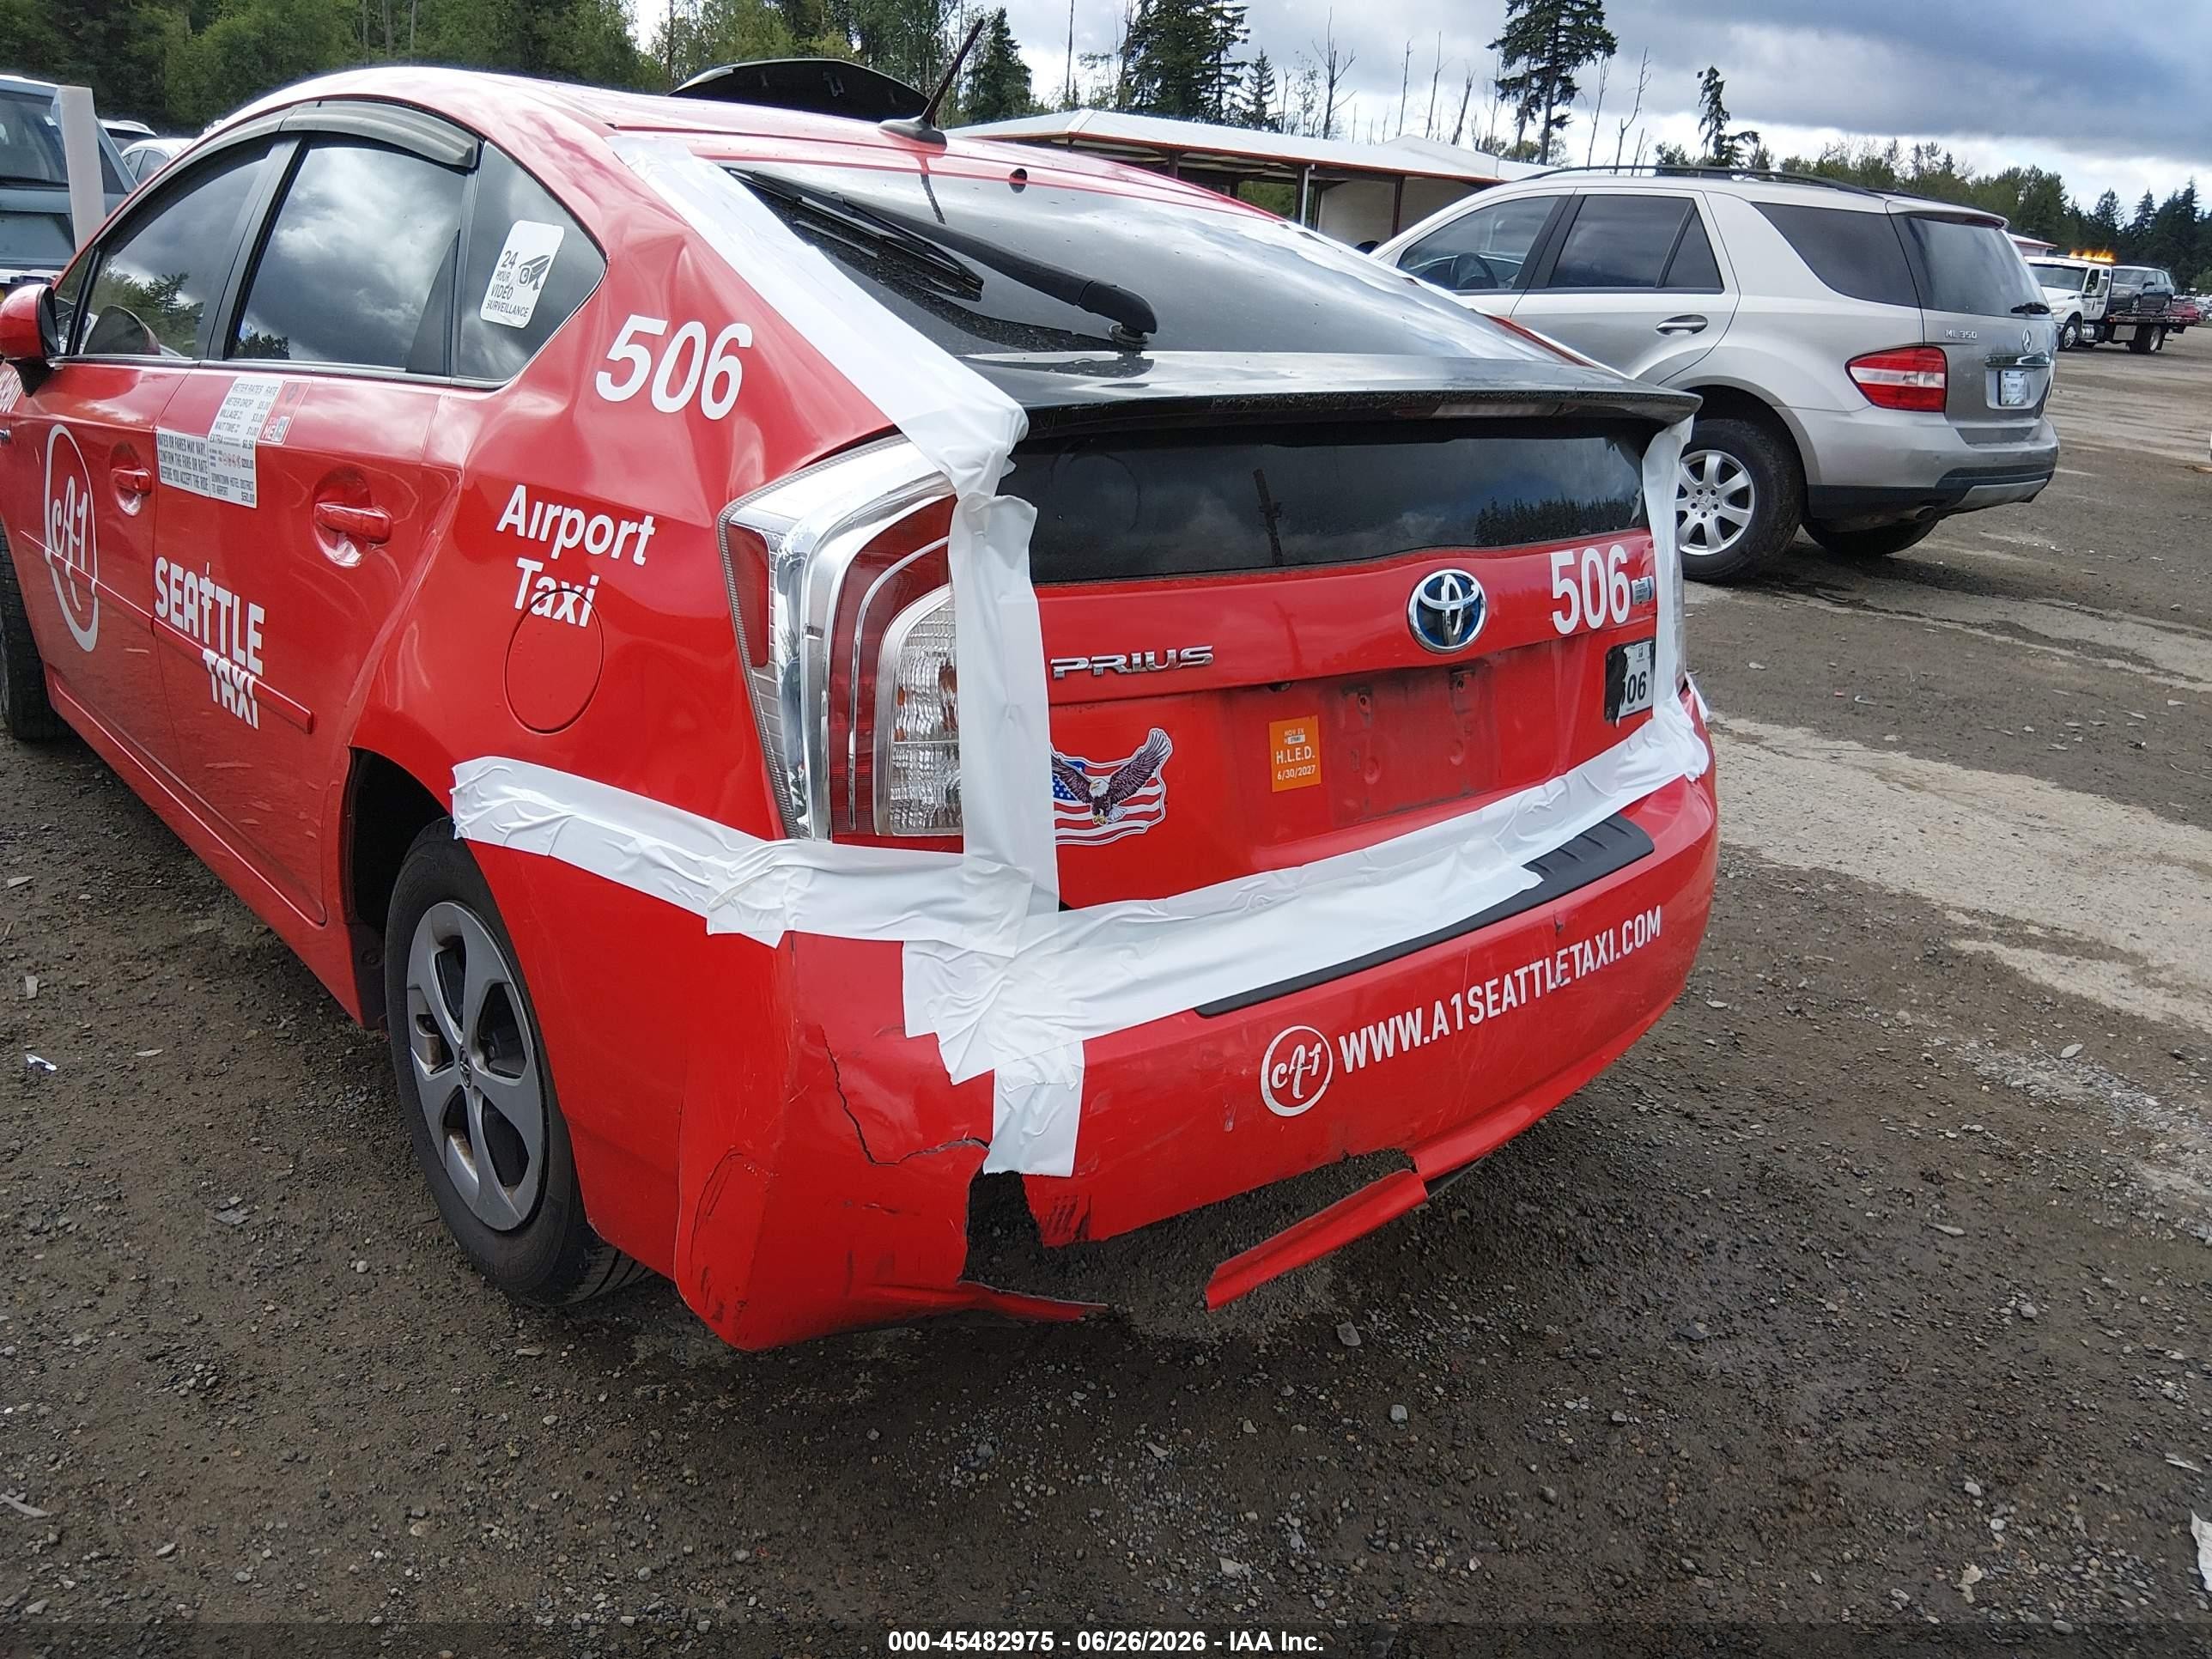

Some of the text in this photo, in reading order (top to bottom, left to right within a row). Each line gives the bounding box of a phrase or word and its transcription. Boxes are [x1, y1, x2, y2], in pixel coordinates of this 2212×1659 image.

[495, 270, 512, 283] HOUR
[501, 250, 519, 269] 24
[485, 299, 530, 318] SURVEILLANCE
[490, 284, 514, 301] VIDEO
[1960, 331, 1978, 339] 350
[596, 314, 753, 420] 506
[496, 484, 656, 566] Airport
[514, 557, 599, 628] Taxi
[1551, 544, 1630, 635] 506
[155, 556, 265, 677] SEATTLE
[1050, 645, 1214, 679] PRIUS
[203, 648, 259, 730] TAXI
[1621, 672, 1647, 706] 06
[1276, 745, 1316, 764] H.L.E.D.
[1277, 764, 1316, 781] 6/30/2027
[1338, 904, 1662, 1073] WWW.A1SEATTLETAXI.COM
